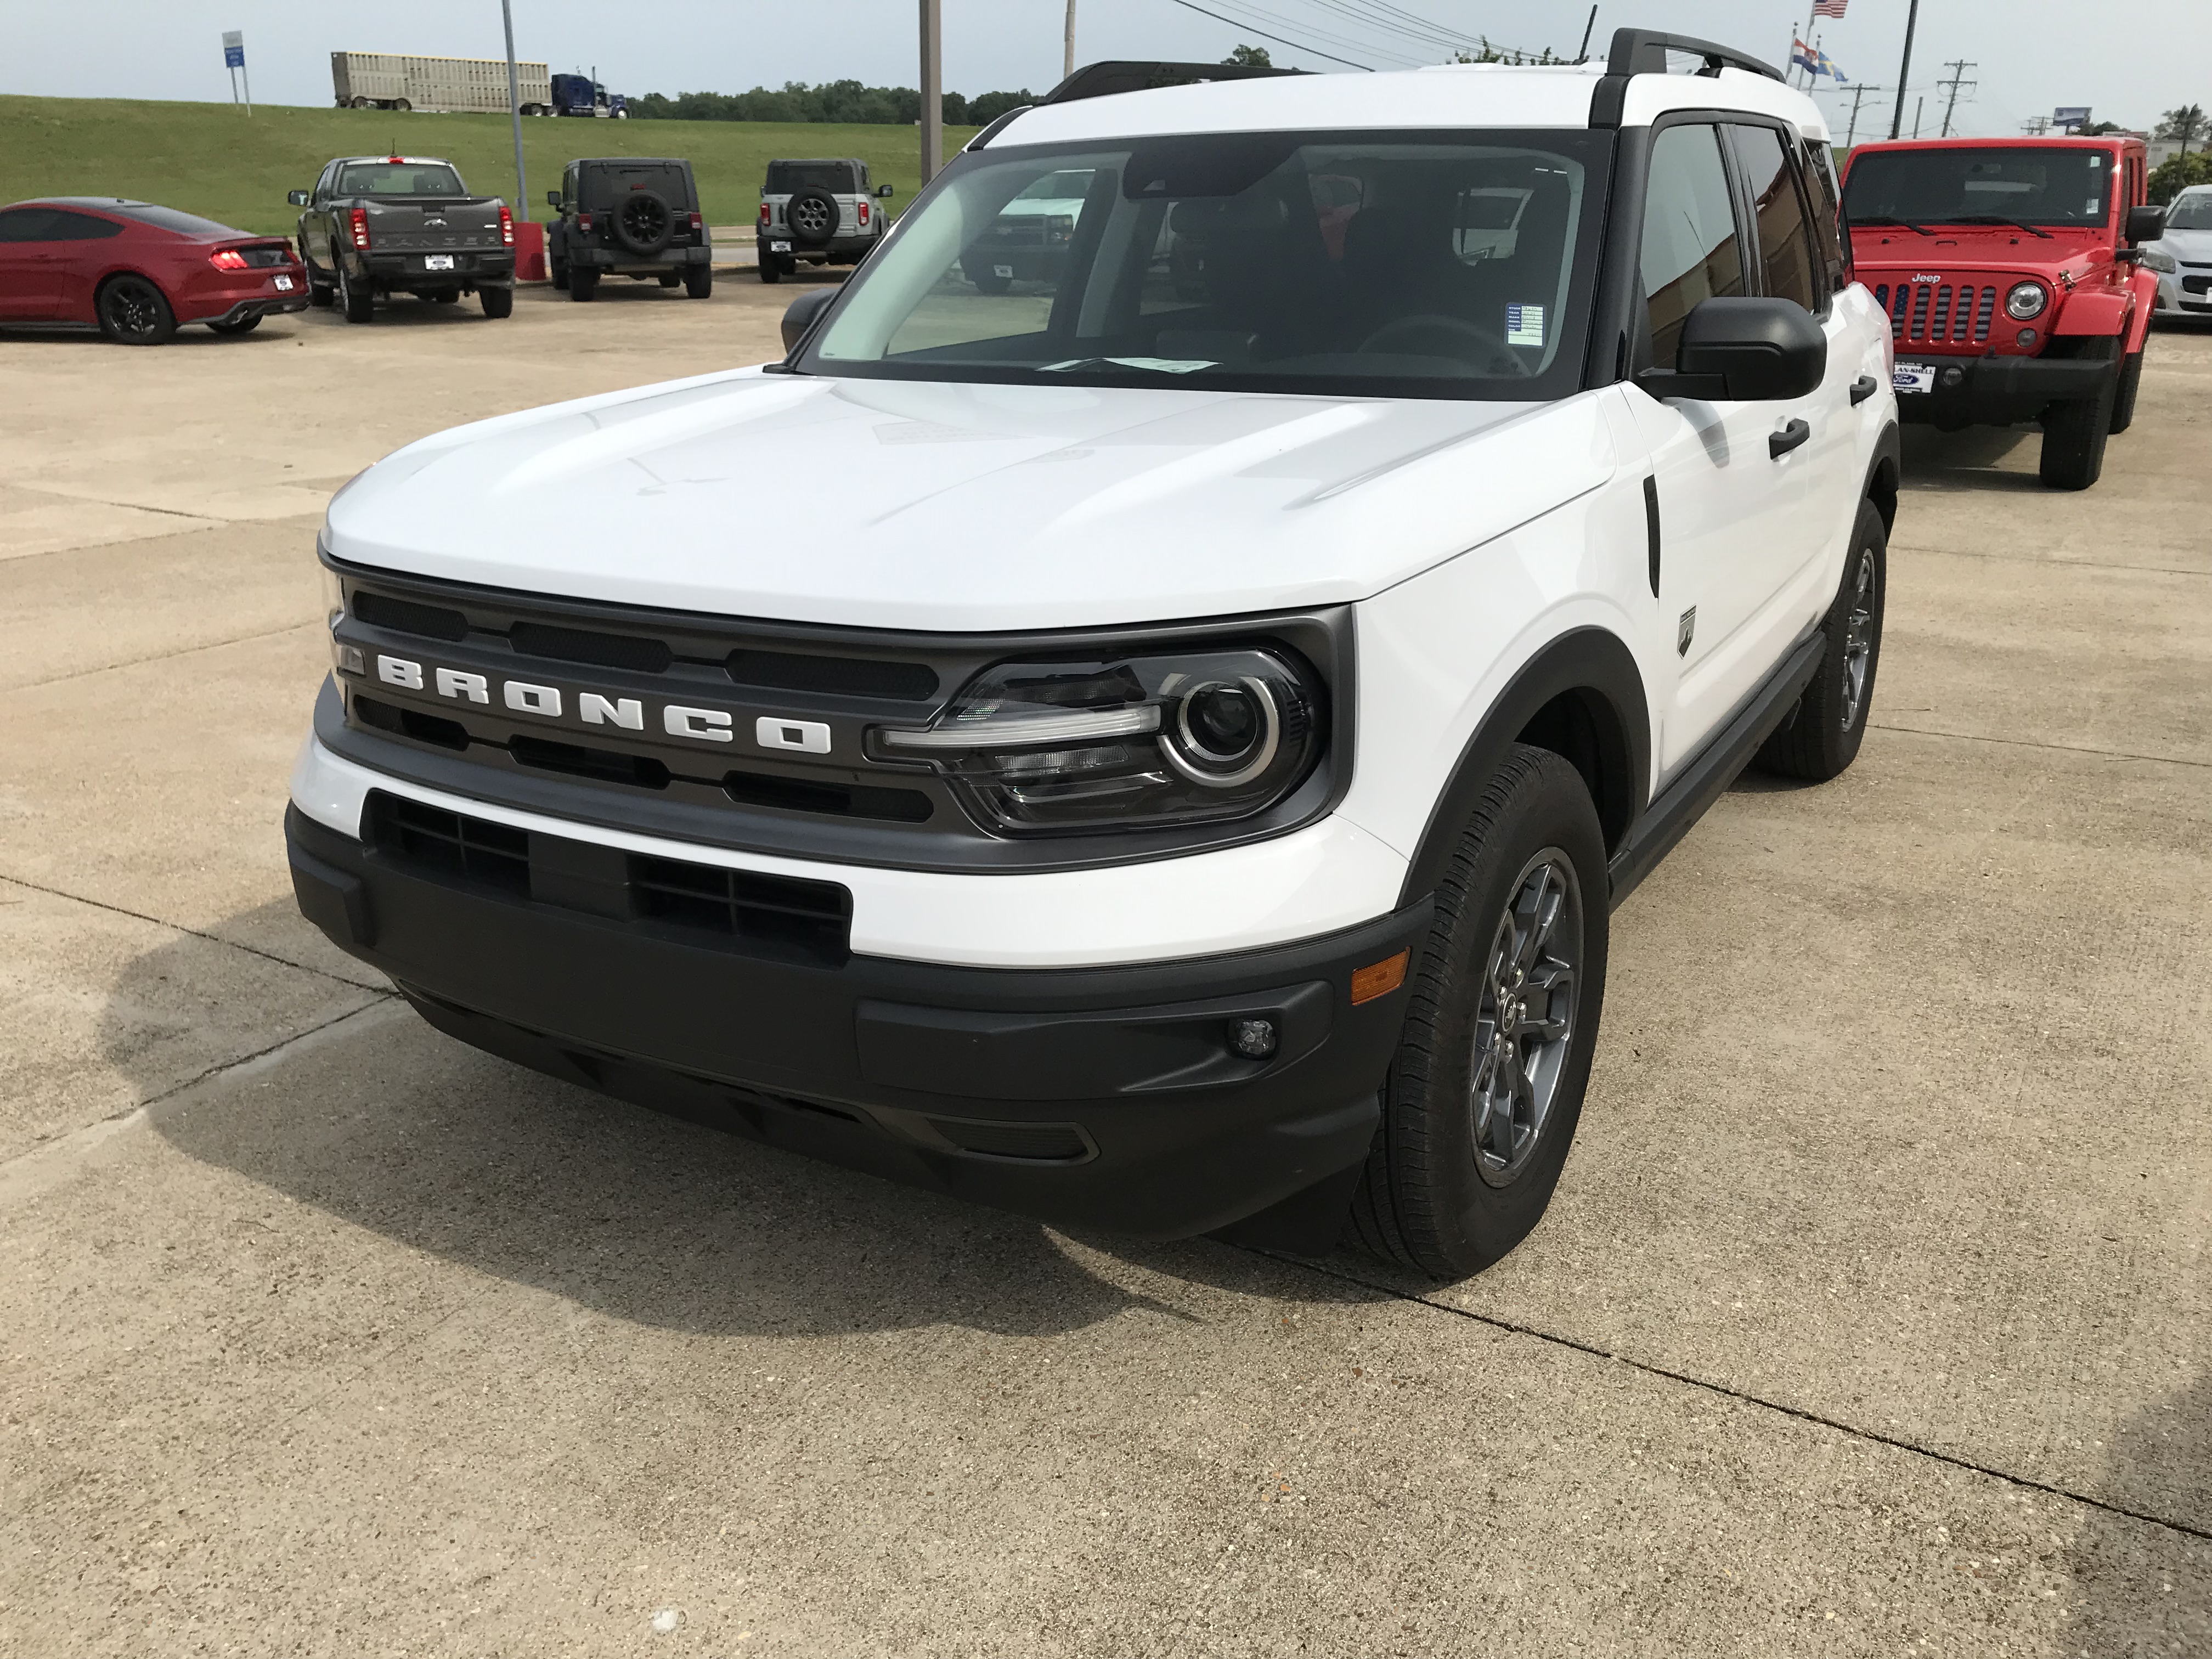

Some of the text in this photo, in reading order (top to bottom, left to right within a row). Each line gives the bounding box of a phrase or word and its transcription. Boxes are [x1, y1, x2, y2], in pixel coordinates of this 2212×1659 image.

[1912, 273, 1941, 284] Jeep
[1893, 375, 1914, 383] Ford
[377, 654, 832, 754] BRONCO
